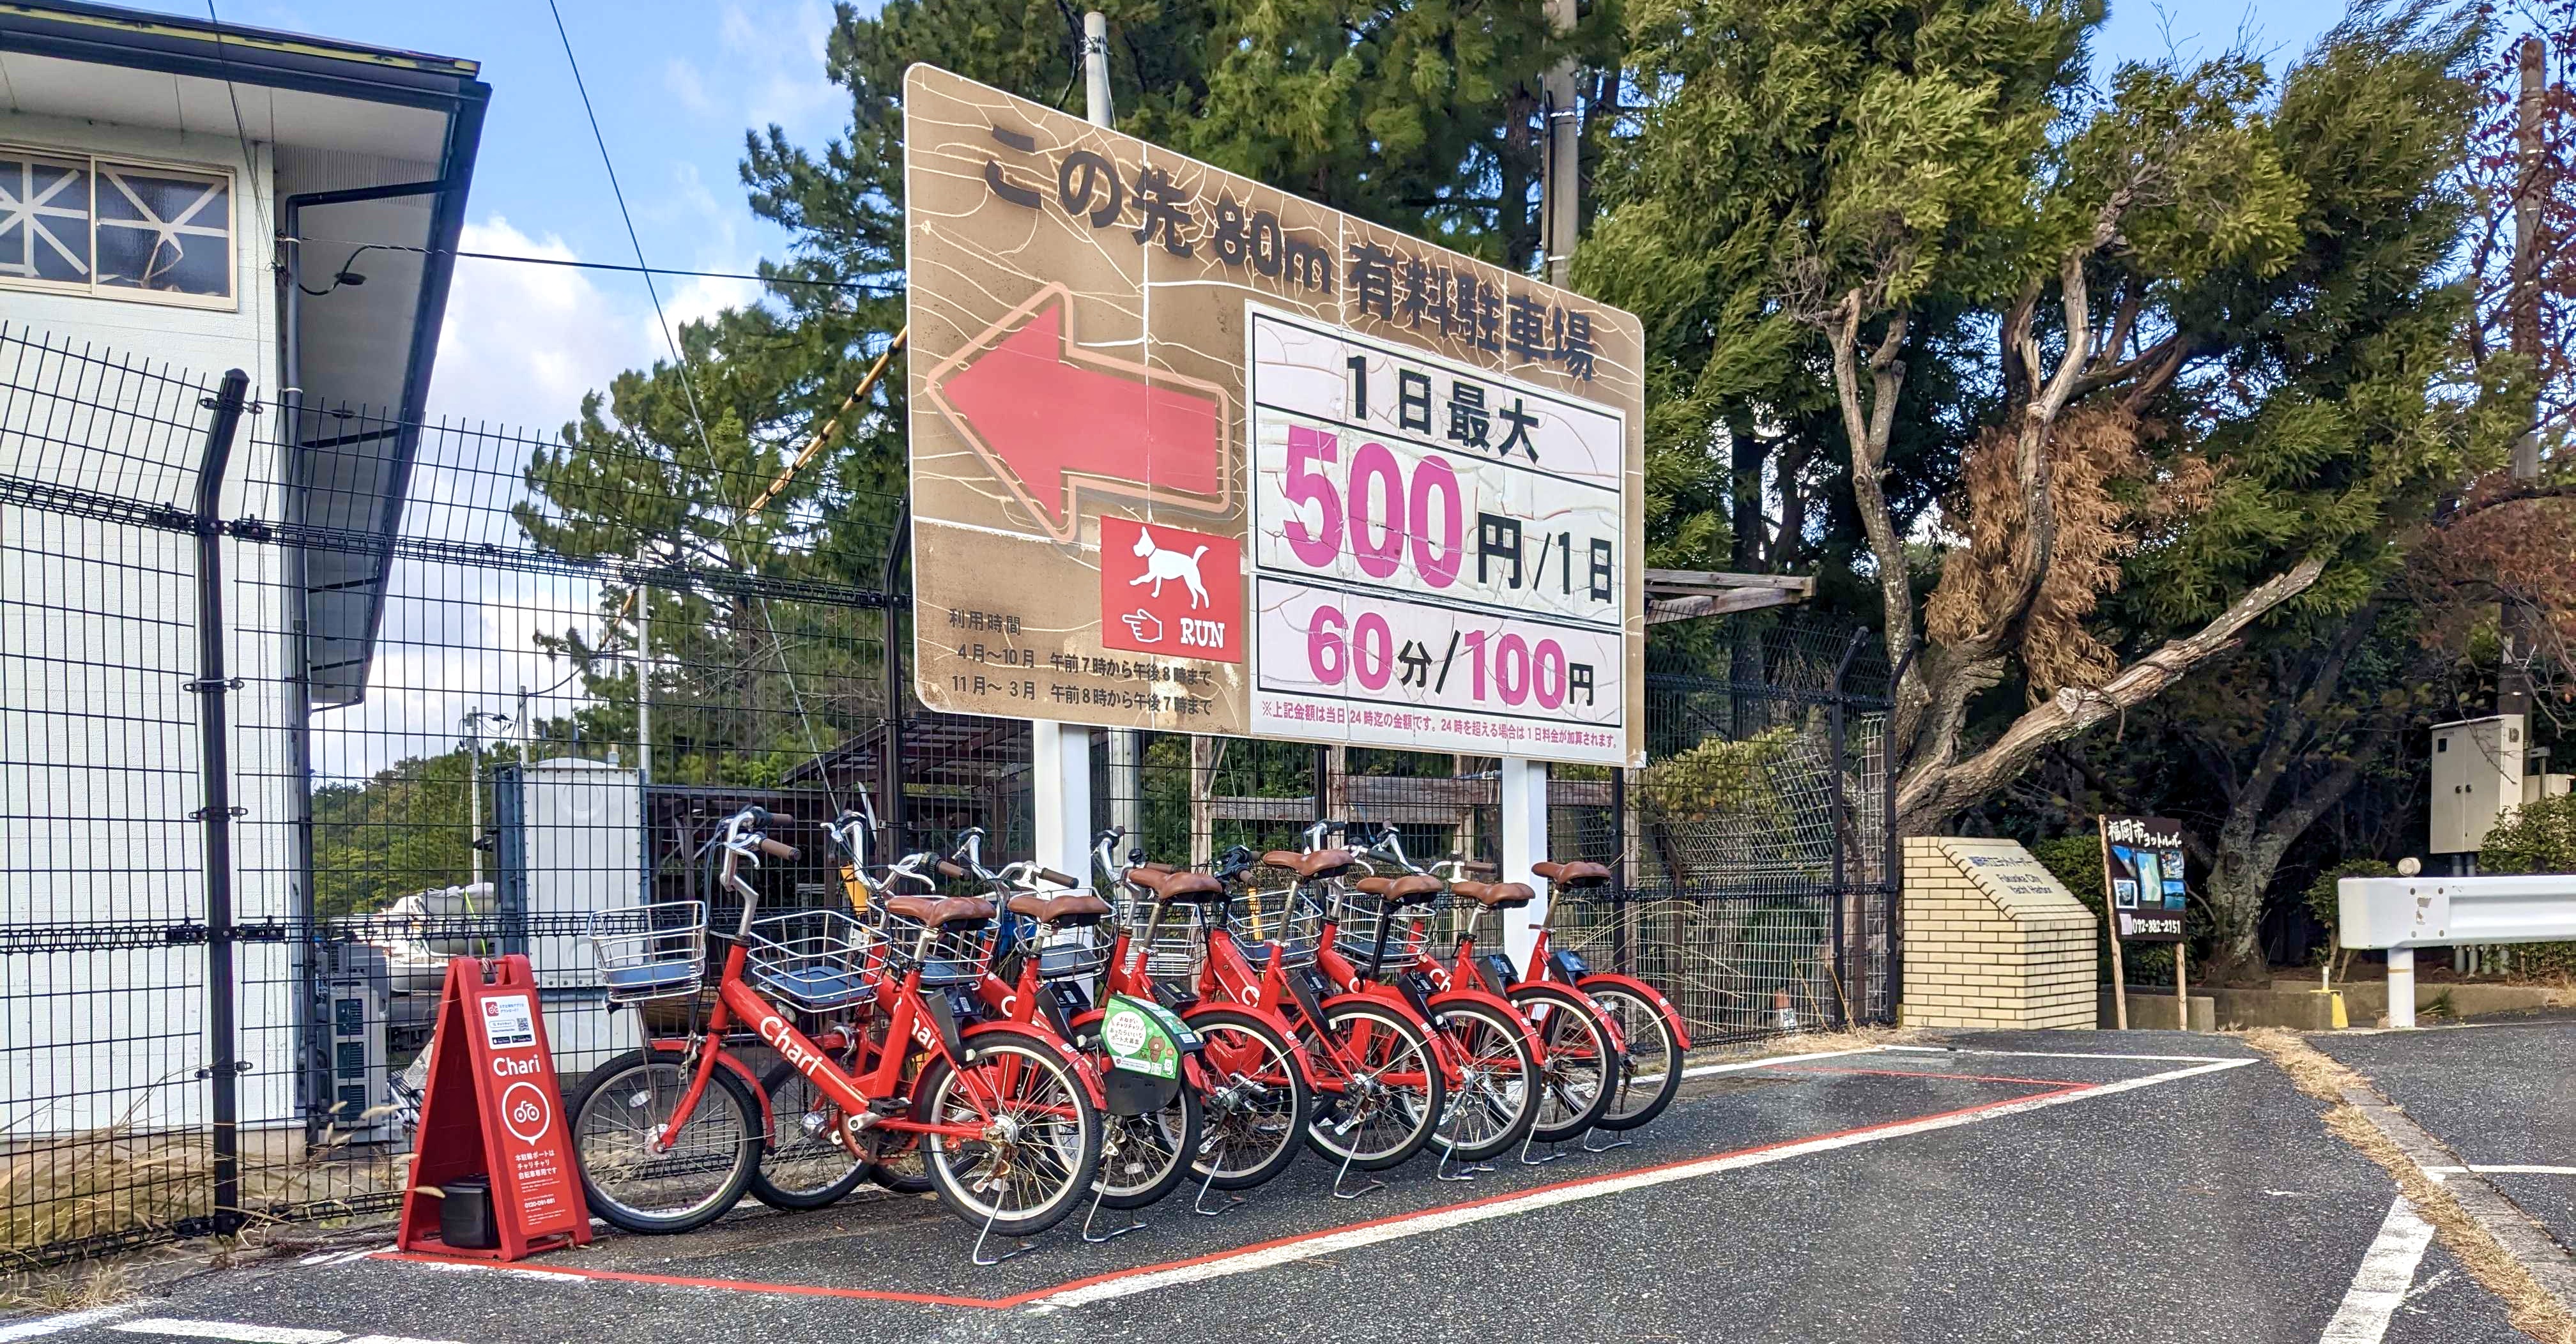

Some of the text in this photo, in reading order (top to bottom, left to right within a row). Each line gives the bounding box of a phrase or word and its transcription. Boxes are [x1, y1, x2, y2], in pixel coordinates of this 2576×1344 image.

[985, 124, 1595, 381] この先 80m 有料駐車場
[1346, 355, 1540, 466] 1日最大
[949, 607, 1021, 636] 利用時間
[1179, 617, 1226, 649] RUN
[1050, 652, 1212, 687] 午前7時から午後8時まで
[1050, 683, 1213, 716] 午前8時から午後7時まで
[760, 1016, 824, 1076] Chari
[493, 1053, 541, 1077] Chari
